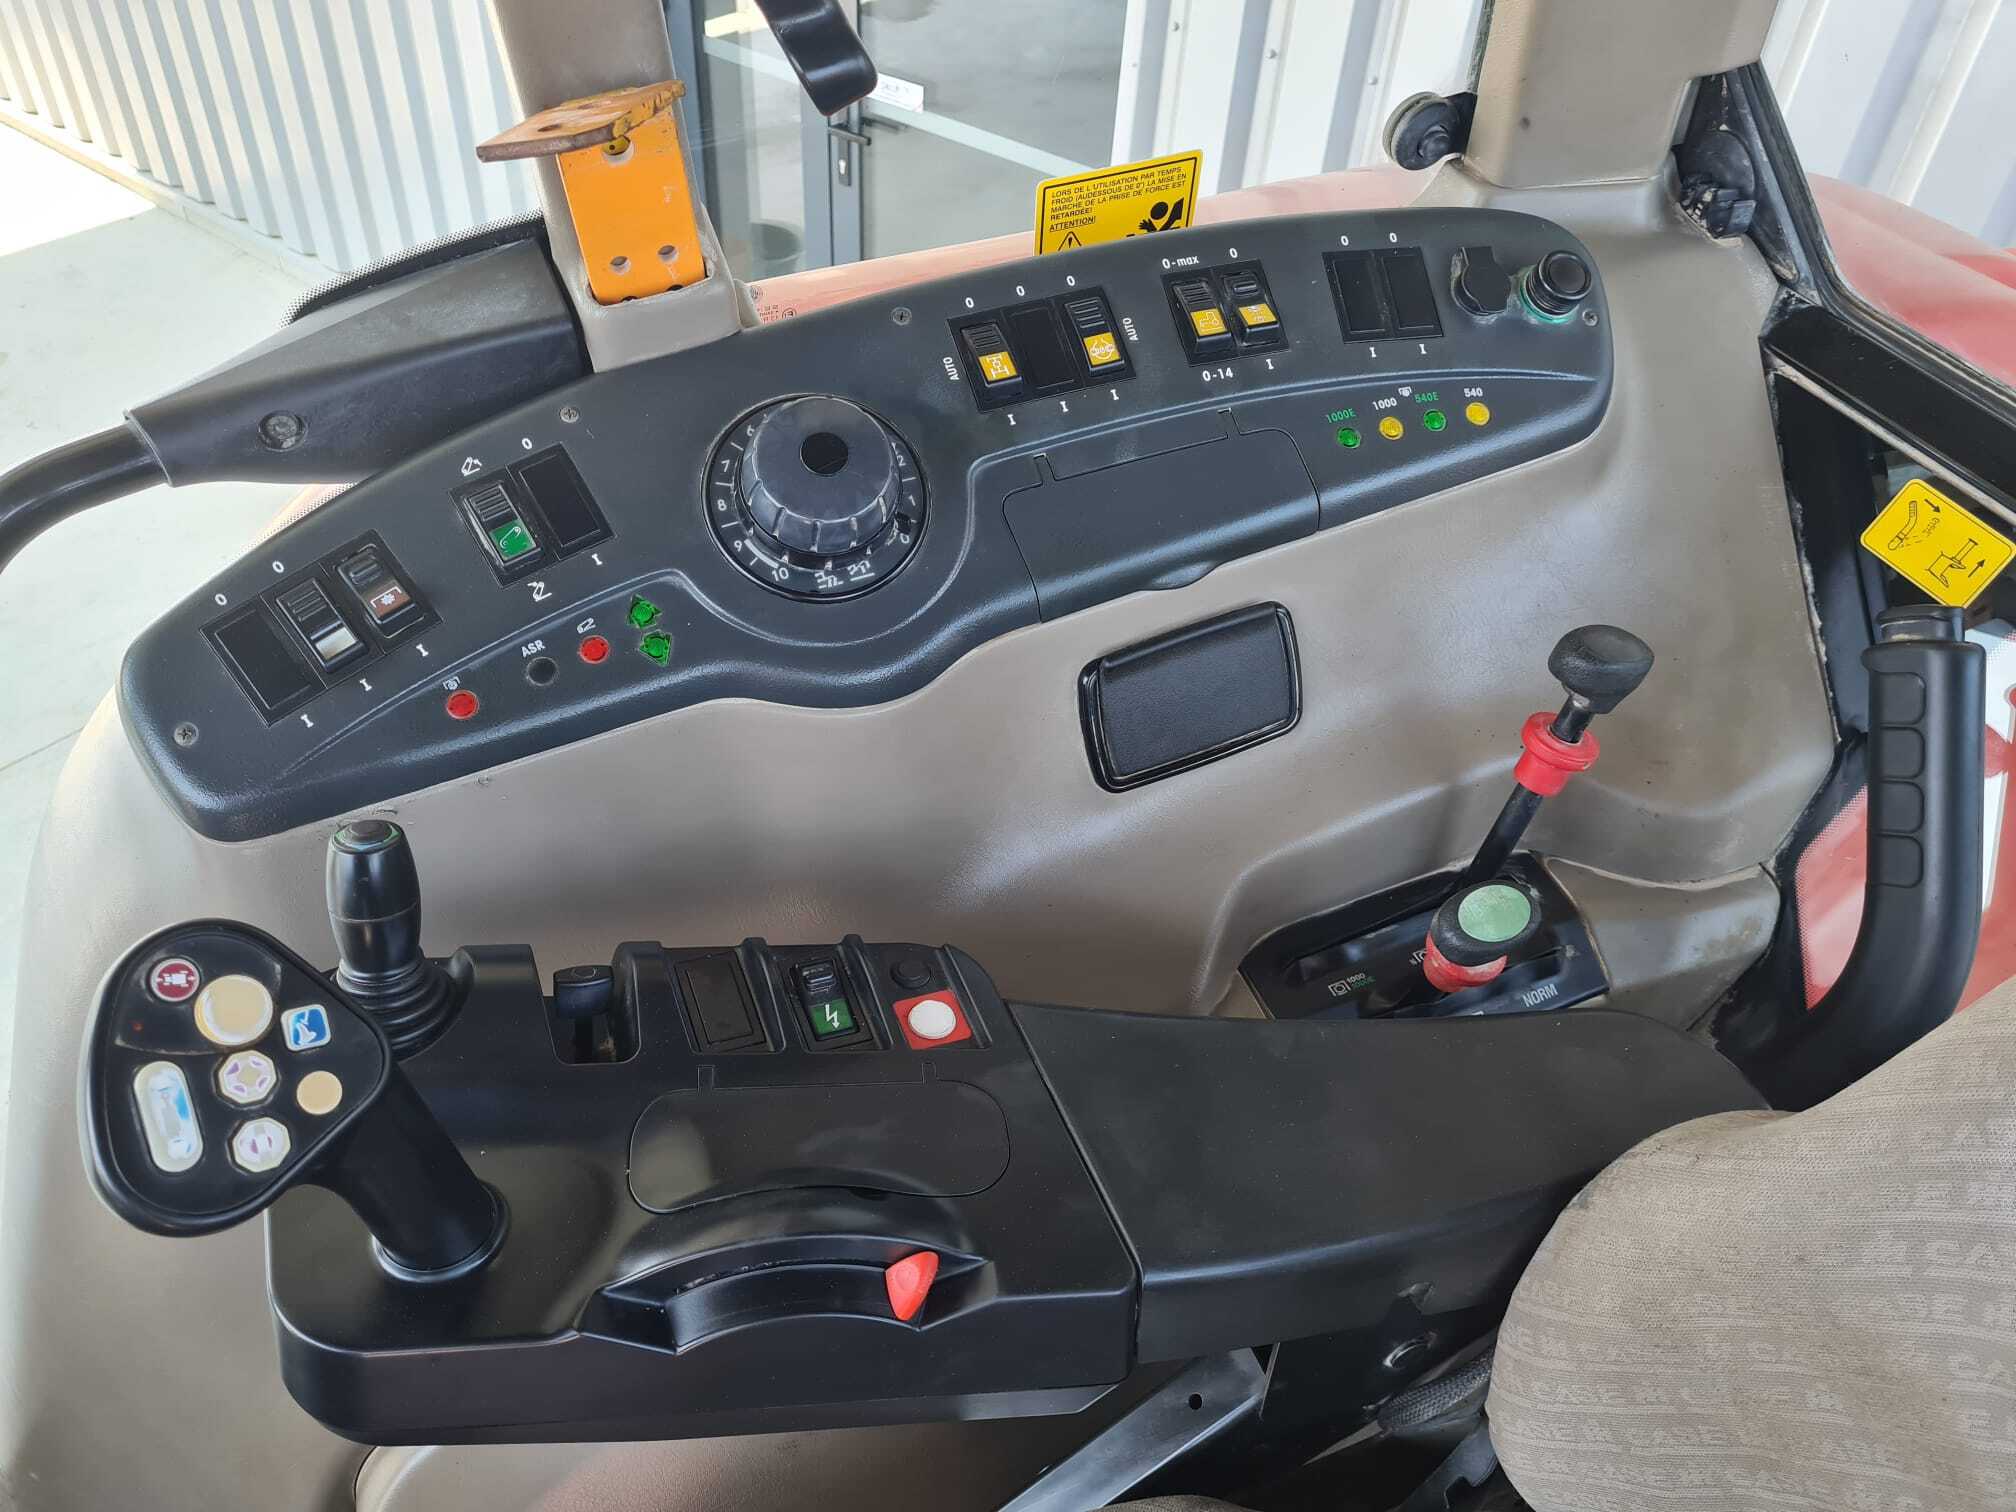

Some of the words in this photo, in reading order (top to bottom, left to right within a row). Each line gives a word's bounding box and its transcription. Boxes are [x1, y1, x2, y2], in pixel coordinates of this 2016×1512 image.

[1051, 197, 1073, 207] FROID
[1158, 175, 1175, 184] MISE
[1052, 189, 1071, 198] LORS
[1074, 185, 1084, 194] DE
[1094, 176, 1138, 190] UTILISATION
[1141, 171, 1155, 181] PAR
[1051, 202, 1083, 214] MARCHE
[1109, 191, 1131, 201] PRISE
[1146, 184, 1169, 194] FORCE
[1172, 180, 1186, 189] EST
[1050, 215, 1096, 231] ATTENTION!
[1162, 254, 1200, 270] 0-max
[1122, 317, 1139, 342] AUTO
[942, 356, 960, 381] AUTO
[1202, 367, 1234, 383] 0-14
[1415, 391, 1439, 403] 540E
[1464, 387, 1484, 399] 540
[1372, 397, 1397, 412] 1000
[1326, 407, 1357, 425] 1000E
[721, 459, 731, 473] 7
[717, 499, 727, 512] 8
[734, 540, 743, 552] 9
[771, 566, 790, 582] 10
[521, 639, 546, 658] ASR
[1522, 983, 1559, 1008] NORM
